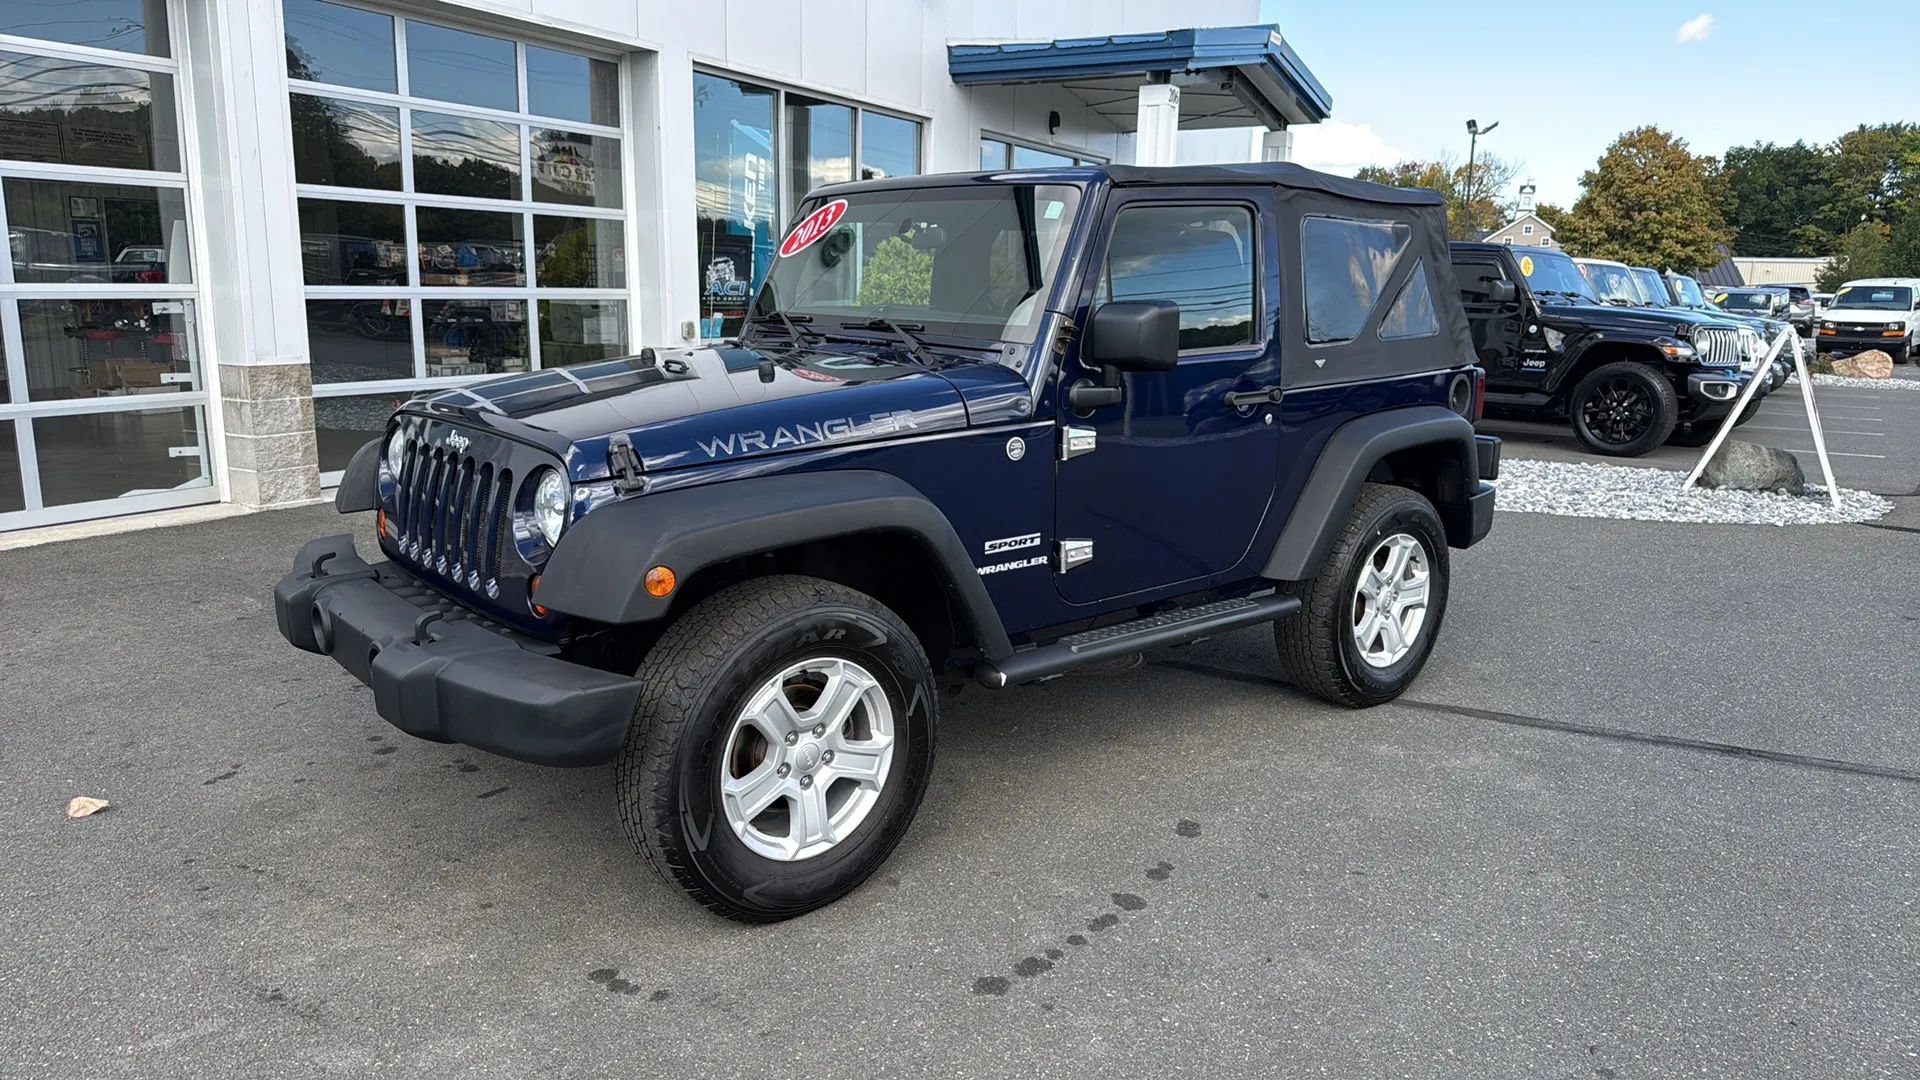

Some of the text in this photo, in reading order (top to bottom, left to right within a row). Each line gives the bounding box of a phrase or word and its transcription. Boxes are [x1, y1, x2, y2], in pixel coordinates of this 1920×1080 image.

[758, 157, 766, 191] TIRES
[789, 205, 836, 253] 2013
[703, 280, 747, 295] ACI
[1522, 358, 1546, 369] Jeep
[446, 429, 471, 454] Jeep
[696, 409, 918, 458] WRANGLER
[988, 536, 1038, 551] SPORT
[977, 556, 1048, 575] WRANGLER
